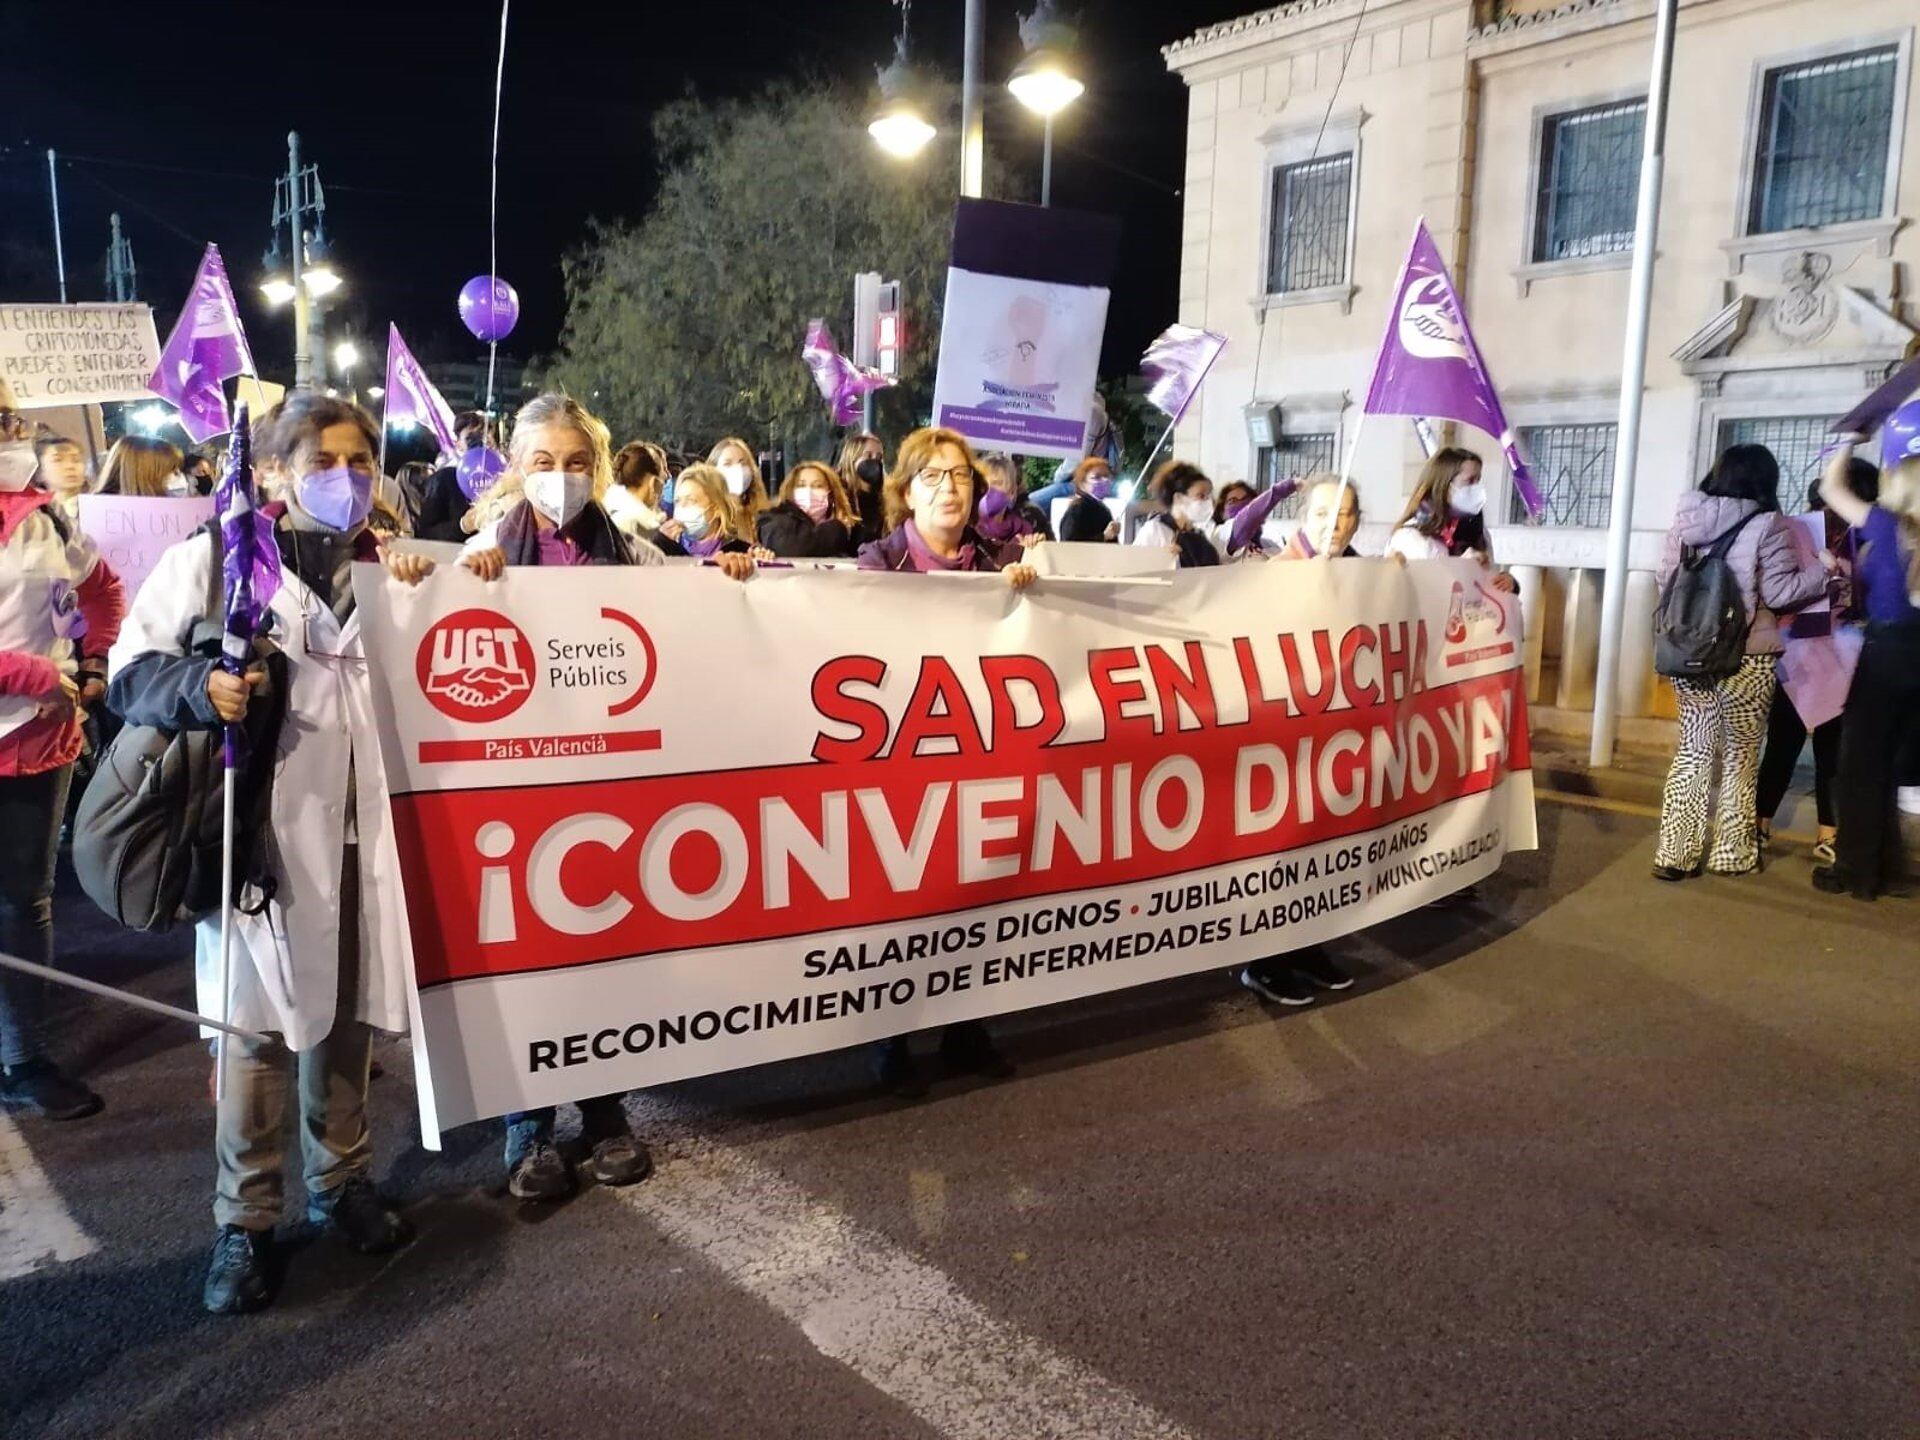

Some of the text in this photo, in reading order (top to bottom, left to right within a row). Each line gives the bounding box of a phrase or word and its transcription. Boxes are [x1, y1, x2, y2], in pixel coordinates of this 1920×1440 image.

[13, 308, 103, 331] ENTIENDES
[109, 309, 137, 330] LAS
[25, 331, 142, 353] CRIPTOMONEDAS
[5, 352, 149, 375] PUEDES ENTENDER
[13, 380, 33, 398] EL
[105, 508, 136, 535] EN
[150, 513, 180, 537] UN
[431, 628, 521, 672] UGT
[547, 637, 625, 661] Serveis
[550, 665, 628, 688] Públics
[811, 619, 1429, 763] SAD EN LUCHA
[485, 734, 608, 759] País Valencià
[474, 754, 1205, 944] ¡CONVENIO
[1234, 712, 1439, 836] DIGNO
[803, 822, 1429, 978] SALARIOS DIGNOS JUBILACIÓN A LOS 60 AÑOS
[529, 978, 916, 1073] RECONOCIMIENTO
[927, 964, 972, 998] DE
[983, 917, 1232, 986] ENFERMEDADES
[1240, 881, 1362, 937] LABORALES
